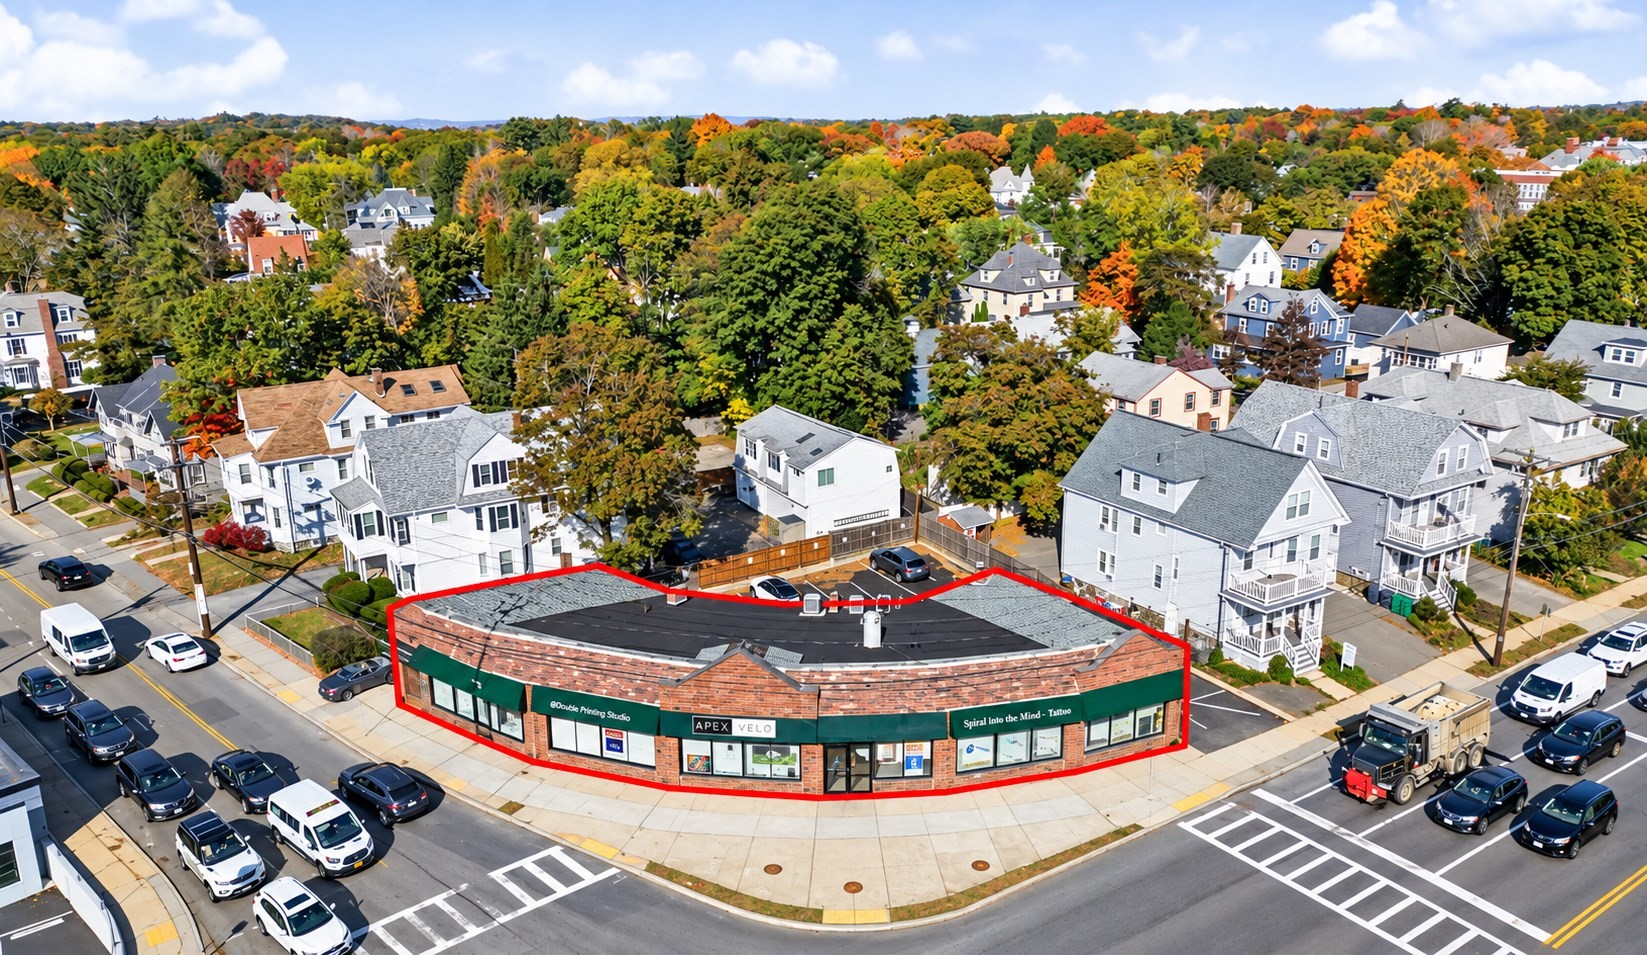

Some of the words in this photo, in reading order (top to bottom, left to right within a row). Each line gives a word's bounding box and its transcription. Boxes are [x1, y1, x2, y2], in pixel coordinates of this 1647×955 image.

[580, 706, 605, 718] Printing
[607, 711, 631, 721] Studio
[963, 717, 987, 730] Spiral
[1005, 714, 1018, 723] the
[1020, 710, 1041, 720] Mind
[1048, 708, 1072, 717] Tattoo
[695, 721, 729, 732] APEX
[738, 723, 772, 734] VELO
